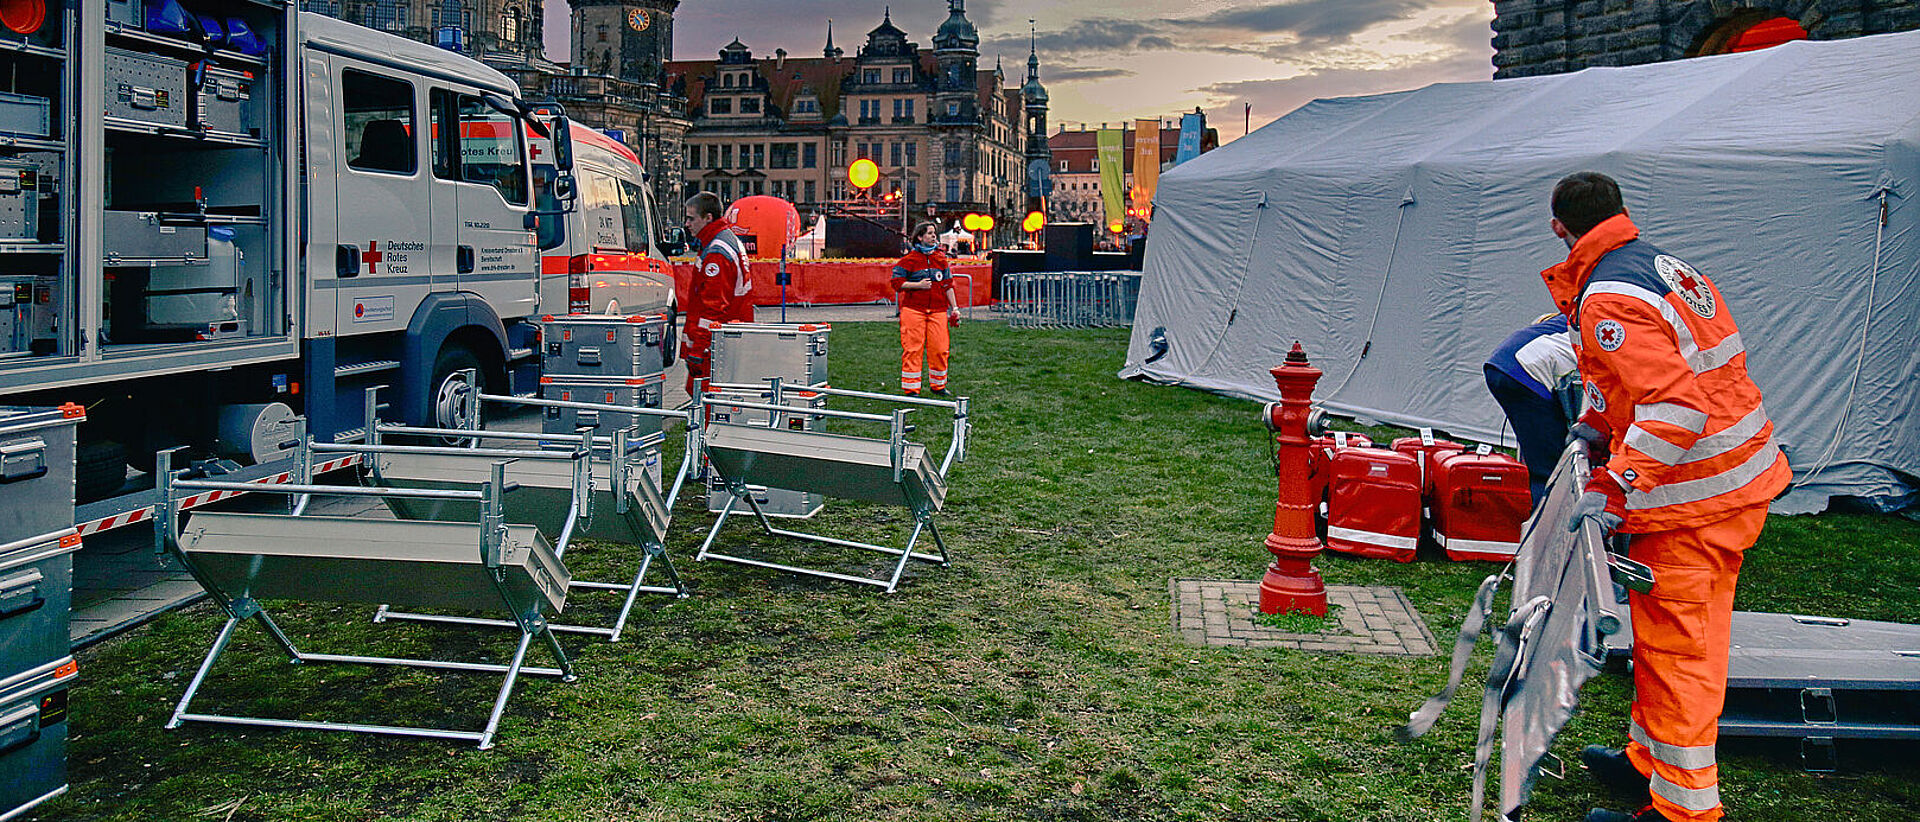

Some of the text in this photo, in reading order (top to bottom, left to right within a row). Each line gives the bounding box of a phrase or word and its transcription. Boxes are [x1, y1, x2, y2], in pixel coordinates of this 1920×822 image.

[461, 147, 513, 156] otes Kreu
[387, 240, 424, 251] Deutsches
[386, 252, 408, 262] Rotes
[387, 264, 408, 274] Kreuz
